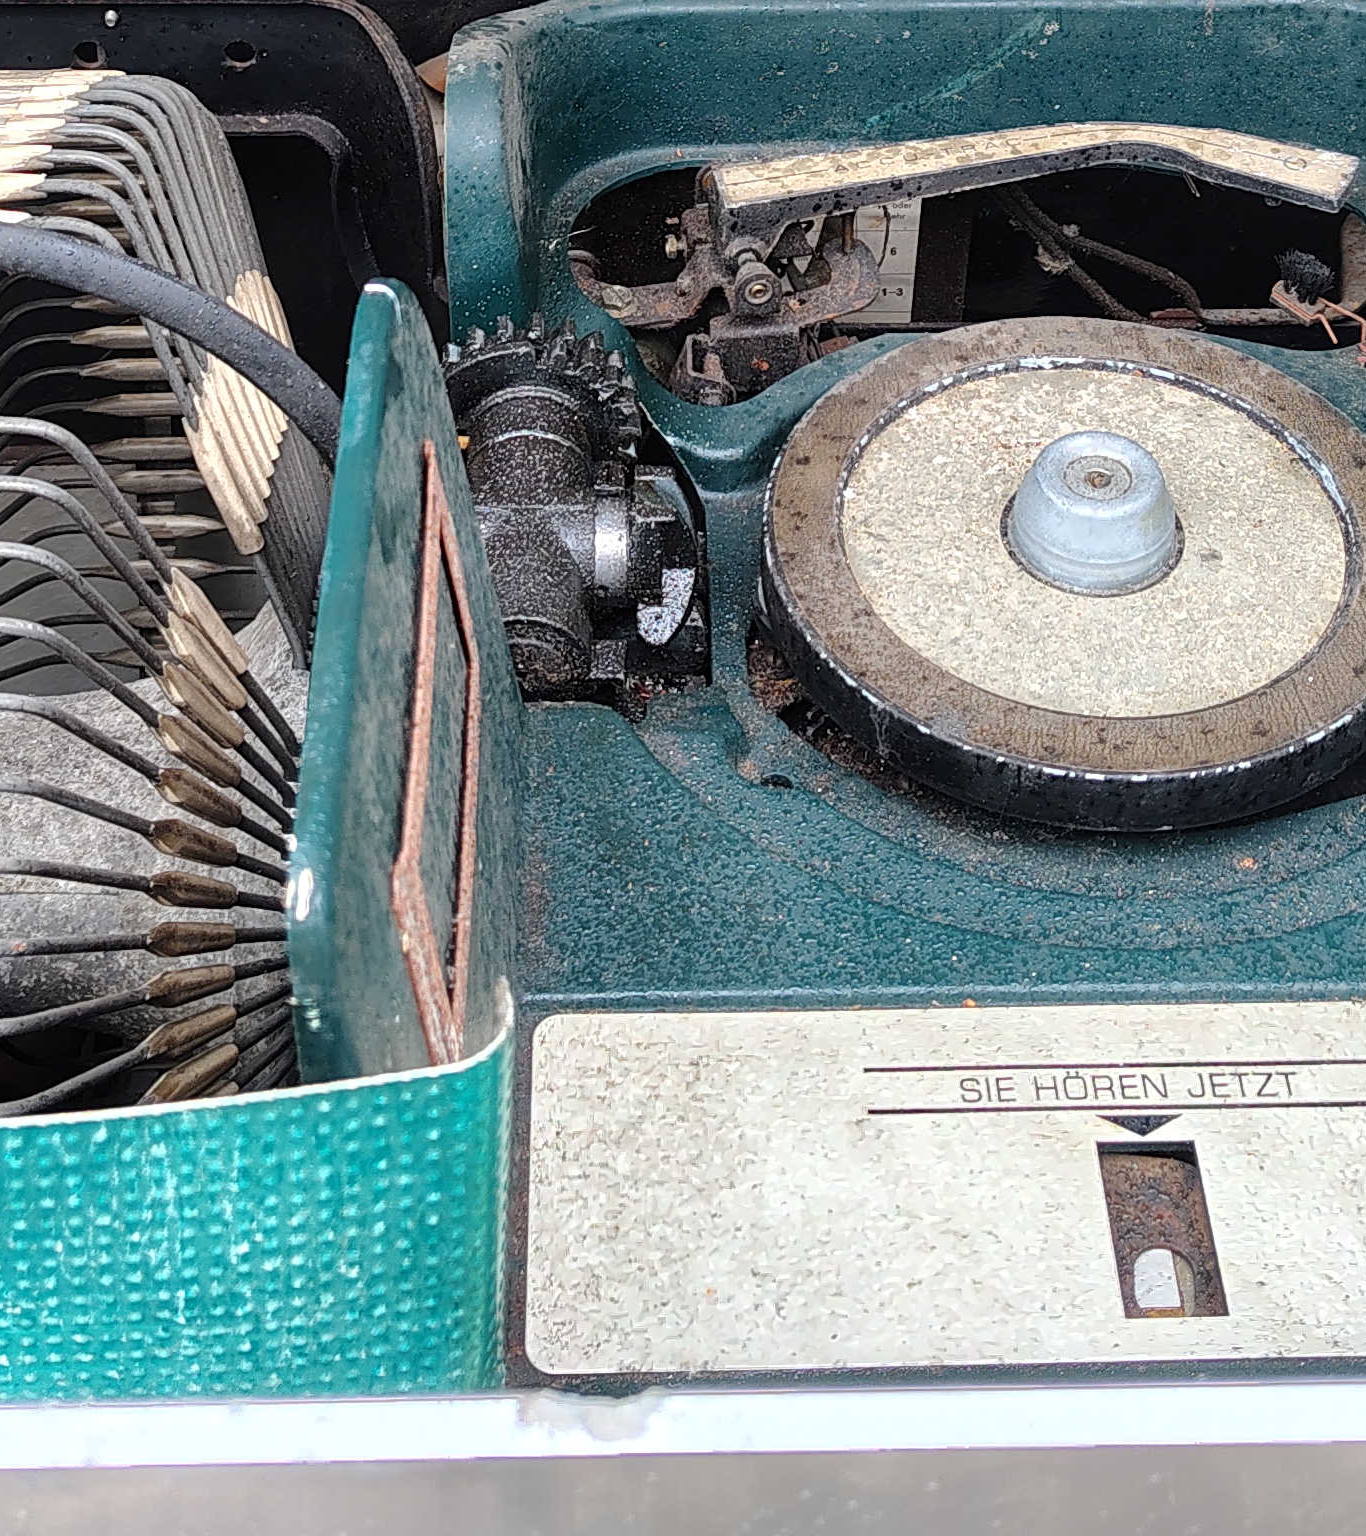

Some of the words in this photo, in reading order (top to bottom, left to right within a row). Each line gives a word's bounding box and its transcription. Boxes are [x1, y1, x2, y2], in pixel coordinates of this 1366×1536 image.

[890, 246, 898, 256] 6
[959, 1076, 1017, 1104] SIE
[1033, 1070, 1168, 1101] HÖREN
[1186, 1071, 1297, 1099] JETZT
